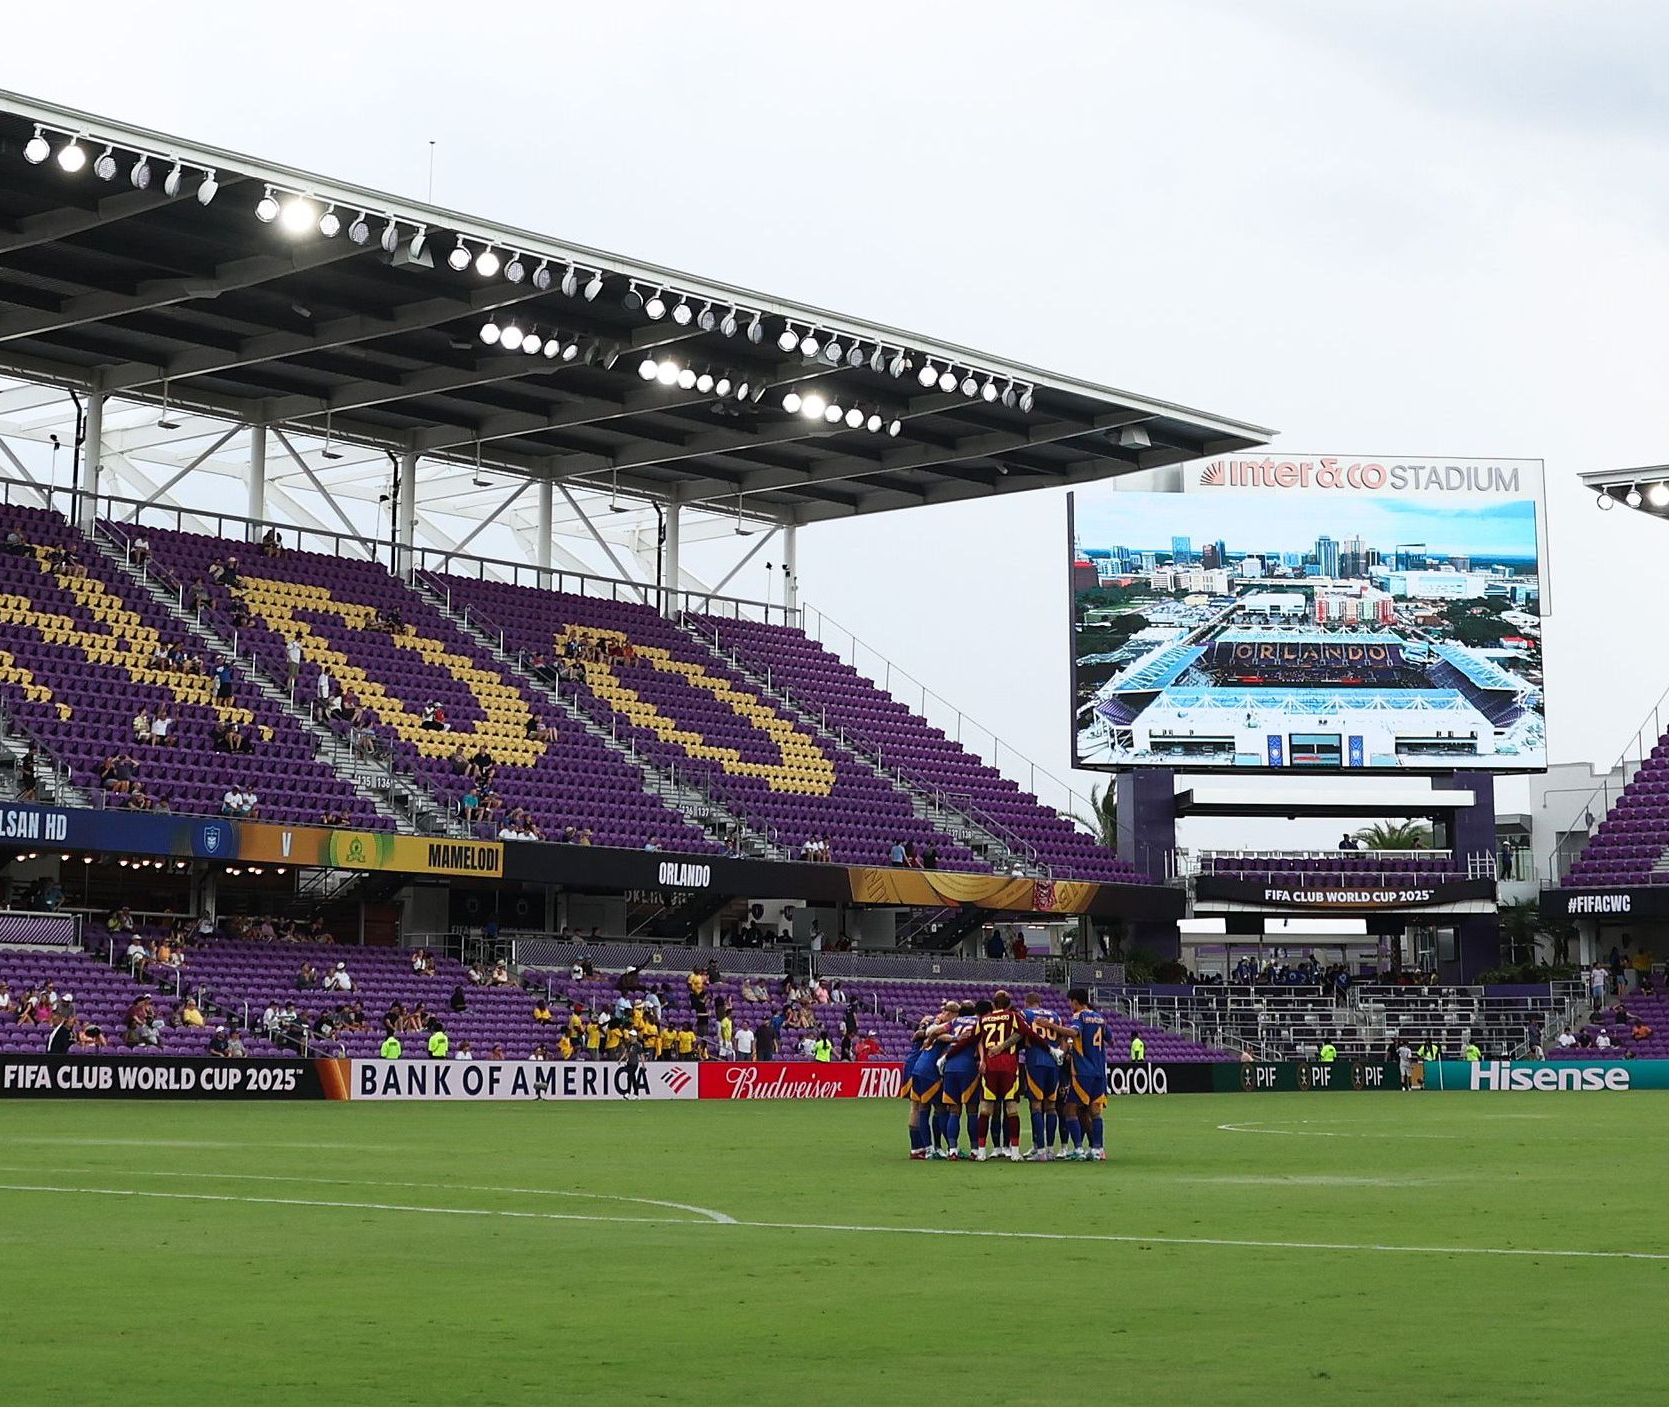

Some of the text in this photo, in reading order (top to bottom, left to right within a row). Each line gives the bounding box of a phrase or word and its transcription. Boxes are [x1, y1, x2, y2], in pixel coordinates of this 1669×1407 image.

[1390, 465, 1519, 492] STADIUM
[1236, 644, 1386, 661] ORLANDO
[44, 813, 68, 841] HD
[281, 832, 292, 857] V
[428, 843, 499, 872] MAMELODI
[659, 862, 711, 888] ORLANDO
[1264, 889, 1290, 902] FIFA
[1293, 891, 1324, 902] CLUB
[1325, 891, 1370, 903] WORLD
[1372, 891, 1397, 903] CUP
[1567, 894, 1631, 914] #FIFACWC
[983, 1022, 1005, 1049] 21
[1092, 1026, 1102, 1052] 4
[4, 1065, 52, 1089] FIFA
[56, 1065, 113, 1090] CLUB
[117, 1066, 196, 1090] WORLD
[199, 1067, 242, 1091] CUP
[361, 1065, 453, 1096] BANK
[462, 1065, 505, 1096] OF
[726, 1066, 902, 1099] Budweiser ZERO
[1256, 1067, 1277, 1088] PIF
[1311, 1067, 1332, 1087] PIF
[1364, 1066, 1384, 1086] PIF
[1470, 1060, 1630, 1091] Hisense
